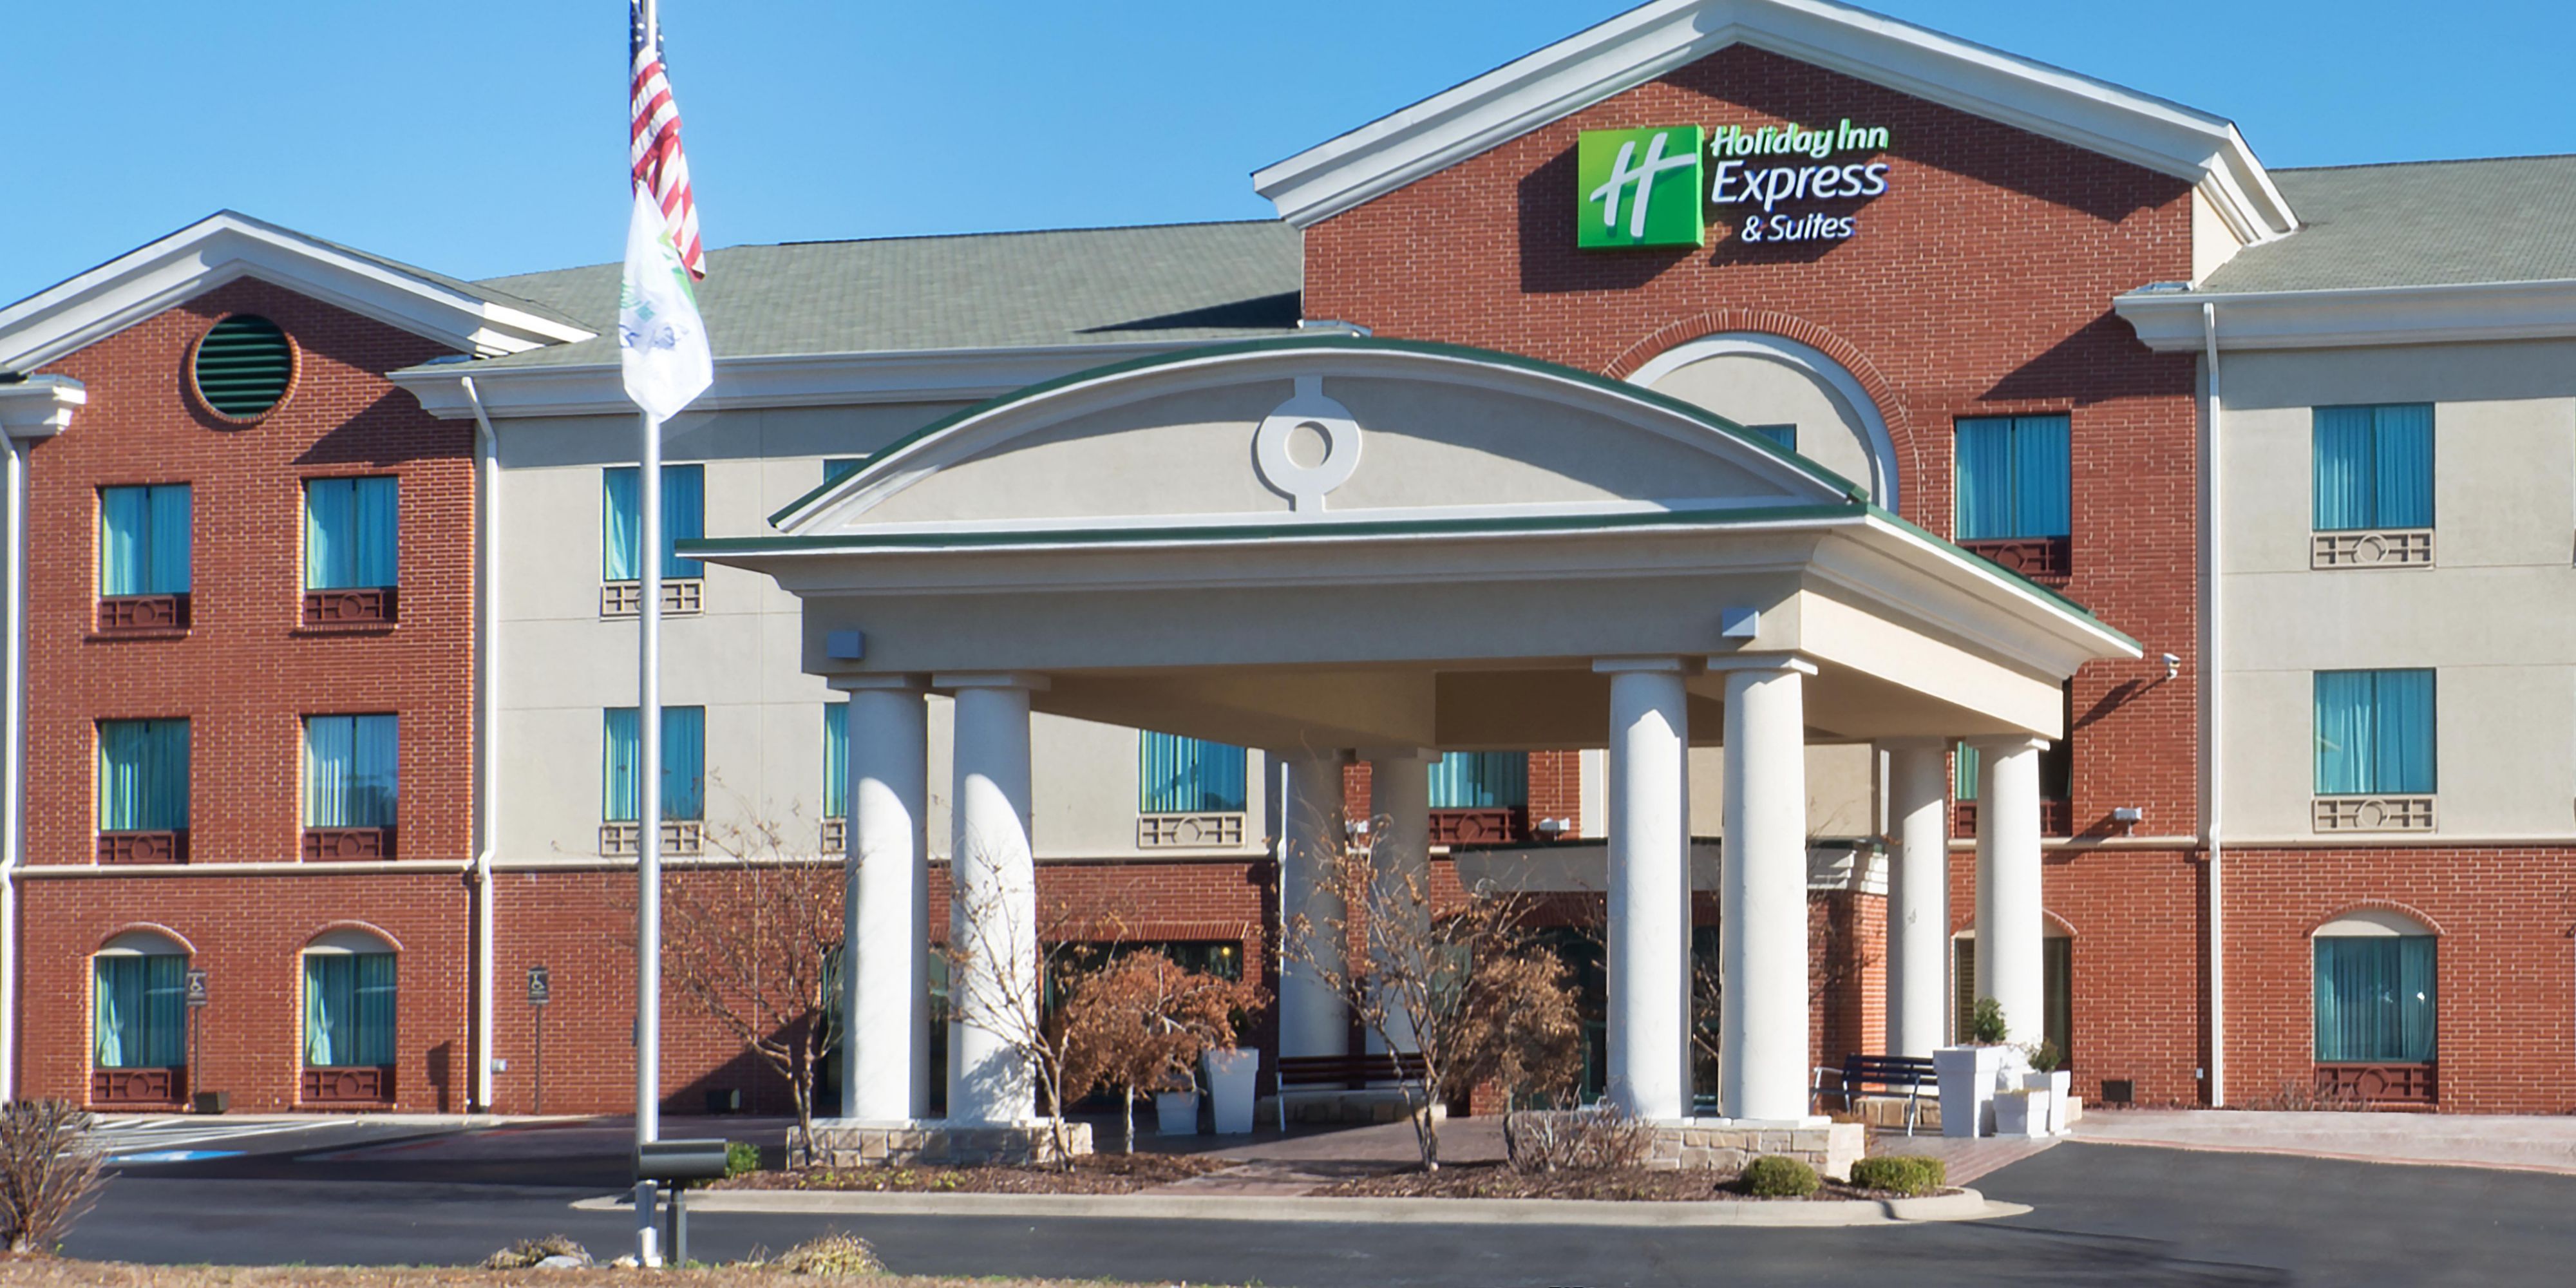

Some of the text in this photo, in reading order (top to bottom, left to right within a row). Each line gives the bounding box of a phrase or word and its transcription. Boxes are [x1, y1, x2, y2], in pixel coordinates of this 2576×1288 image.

[1709, 118, 1889, 159] Holiday Inn
[1711, 160, 1889, 213] Express
[1741, 213, 1855, 242] & Suites
